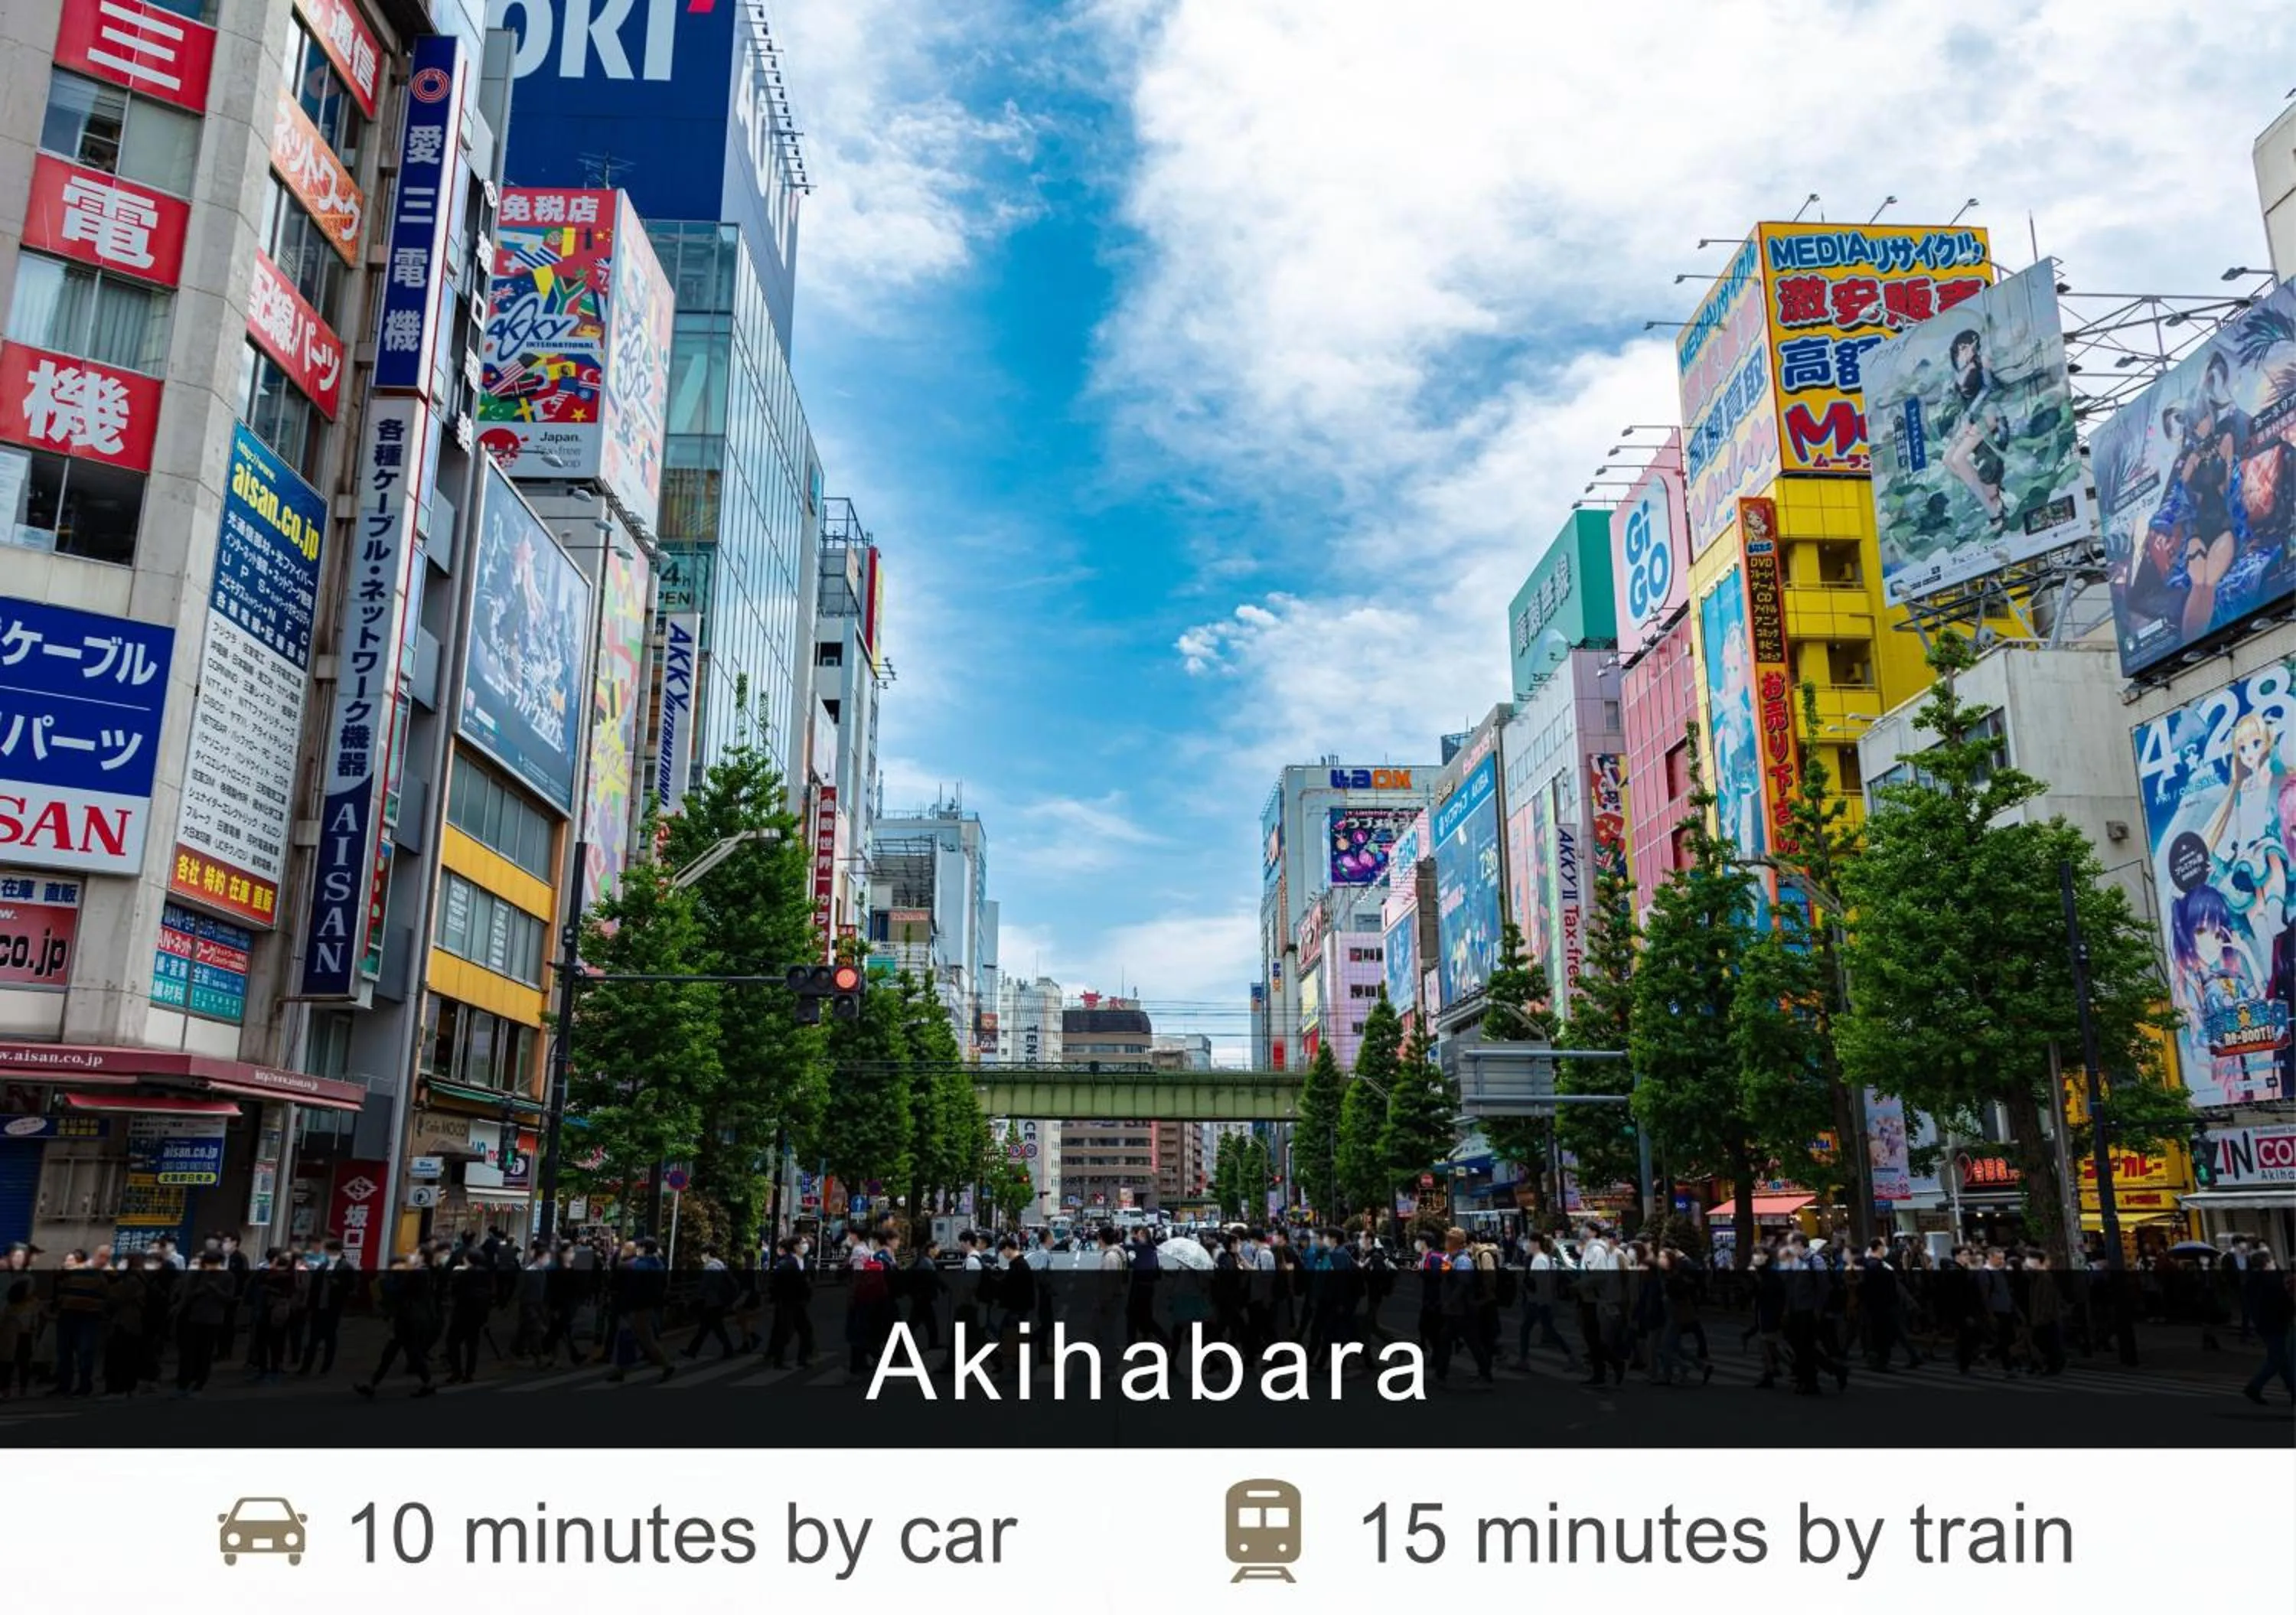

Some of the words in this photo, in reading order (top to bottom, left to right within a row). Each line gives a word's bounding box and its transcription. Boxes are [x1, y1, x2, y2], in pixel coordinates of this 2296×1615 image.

[384, 125, 442, 351] 愛三電機
[501, 194, 599, 223] 免税店
[246, 257, 341, 392] 配線パーツ
[233, 461, 320, 562] aisan.co.jp
[1750, 557, 1773, 567] DVD
[657, 592, 691, 605] PEN
[1756, 592, 1773, 602] CD
[0, 618, 158, 686] ケーブル
[664, 622, 693, 713] AKKY
[0, 711, 143, 771] パーツ
[177, 855, 201, 886] 各社
[229, 875, 251, 905] 在庫
[1557, 828, 1578, 886] AKKY
[2, 878, 36, 899] 在庫
[44, 882, 79, 904] 直販
[314, 802, 359, 974] AISAN
